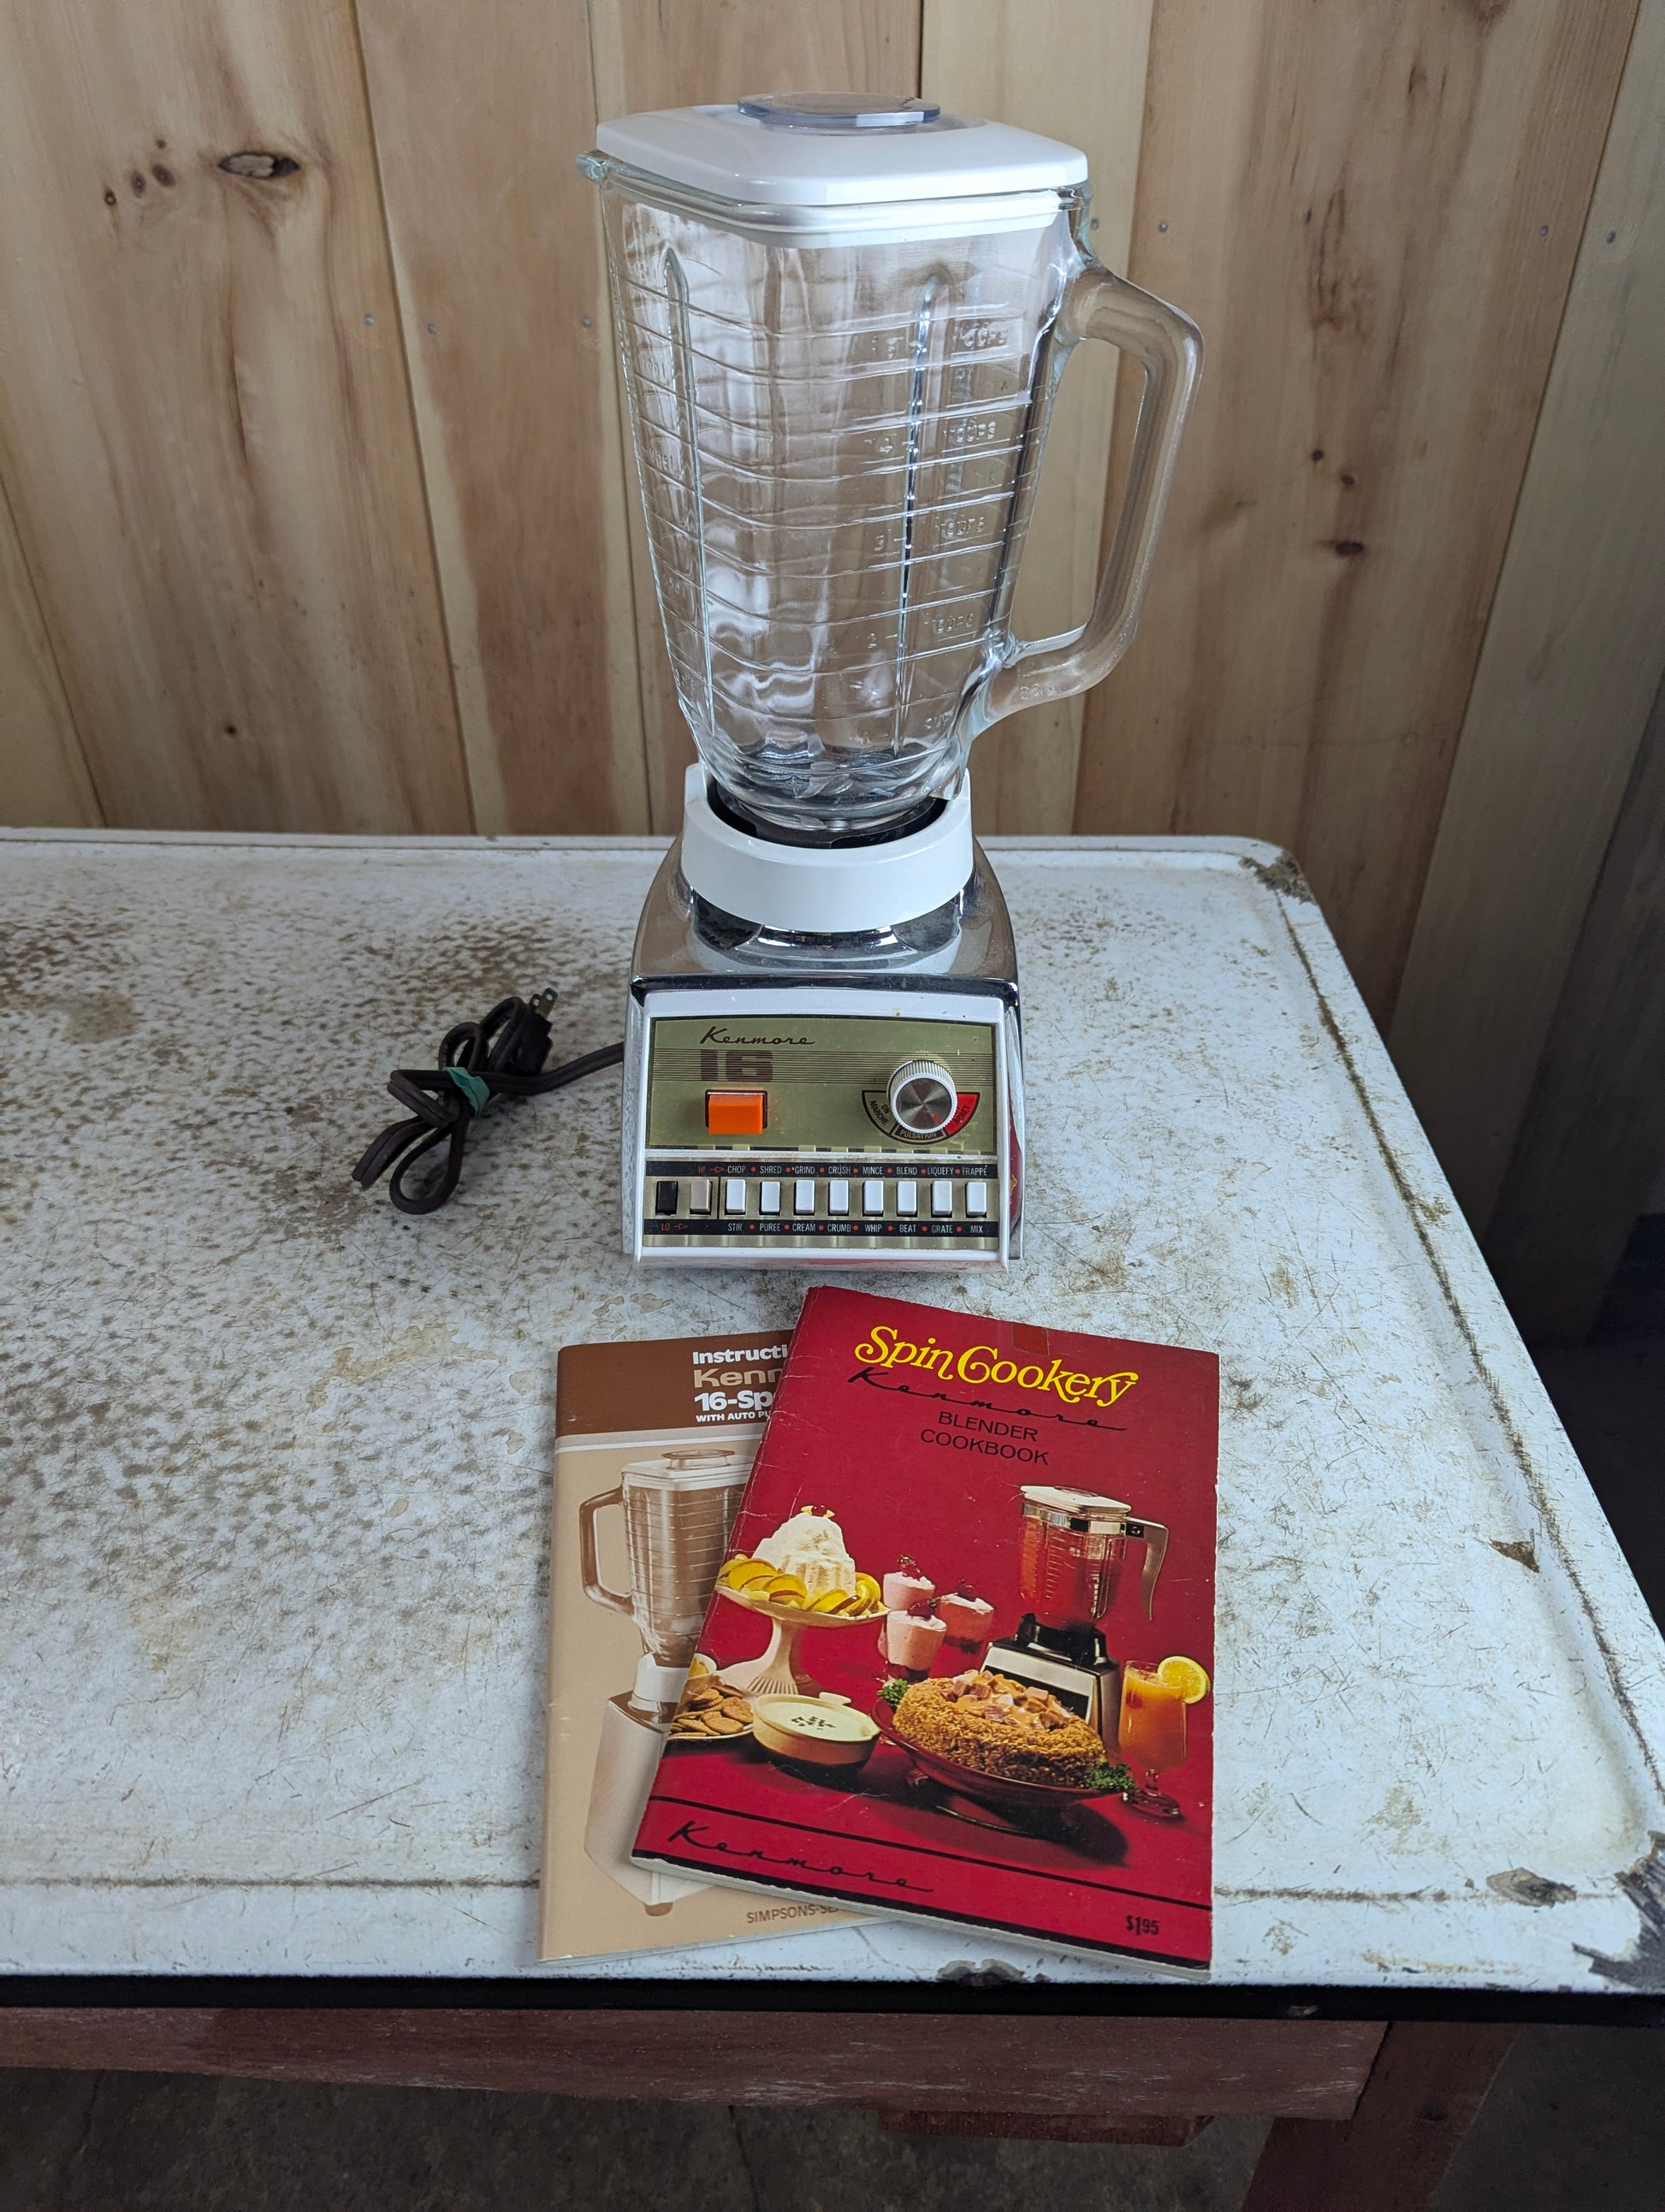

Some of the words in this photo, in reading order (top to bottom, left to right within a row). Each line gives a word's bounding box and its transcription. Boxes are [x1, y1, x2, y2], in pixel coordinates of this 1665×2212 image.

[699, 1026, 816, 1046] Kenmore
[700, 1049, 773, 1082] 16
[869, 1100, 890, 1125] MARCHE
[727, 1165, 746, 1174] CHOP
[760, 1165, 782, 1174] SHRED
[794, 1165, 815, 1175] GRIND
[828, 1166, 851, 1175] CRUSH
[862, 1166, 883, 1175] MINCE
[896, 1166, 917, 1176] BLEND
[927, 1166, 954, 1176] LIQUEFY
[661, 1223, 671, 1231] LO
[727, 1223, 743, 1231] STIR
[759, 1223, 780, 1231] PUREE
[792, 1223, 816, 1231] CREAM
[827, 1223, 851, 1232] CRUMB
[864, 1224, 882, 1232] WHIP
[899, 1224, 916, 1233] BEAT
[932, 1225, 953, 1234] GRATE
[970, 1225, 984, 1234] MIX
[847, 1367, 1128, 1432] Kenmore
[696, 1414, 725, 1422] WITH
[727, 1411, 755, 1421] AUTO
[937, 1411, 1039, 1444] BLENDER
[920, 1427, 1050, 1466] COOKBOOK
[667, 1819, 935, 1894] Kenmore
[746, 1904, 838, 1924] SIMPSONS-SE
